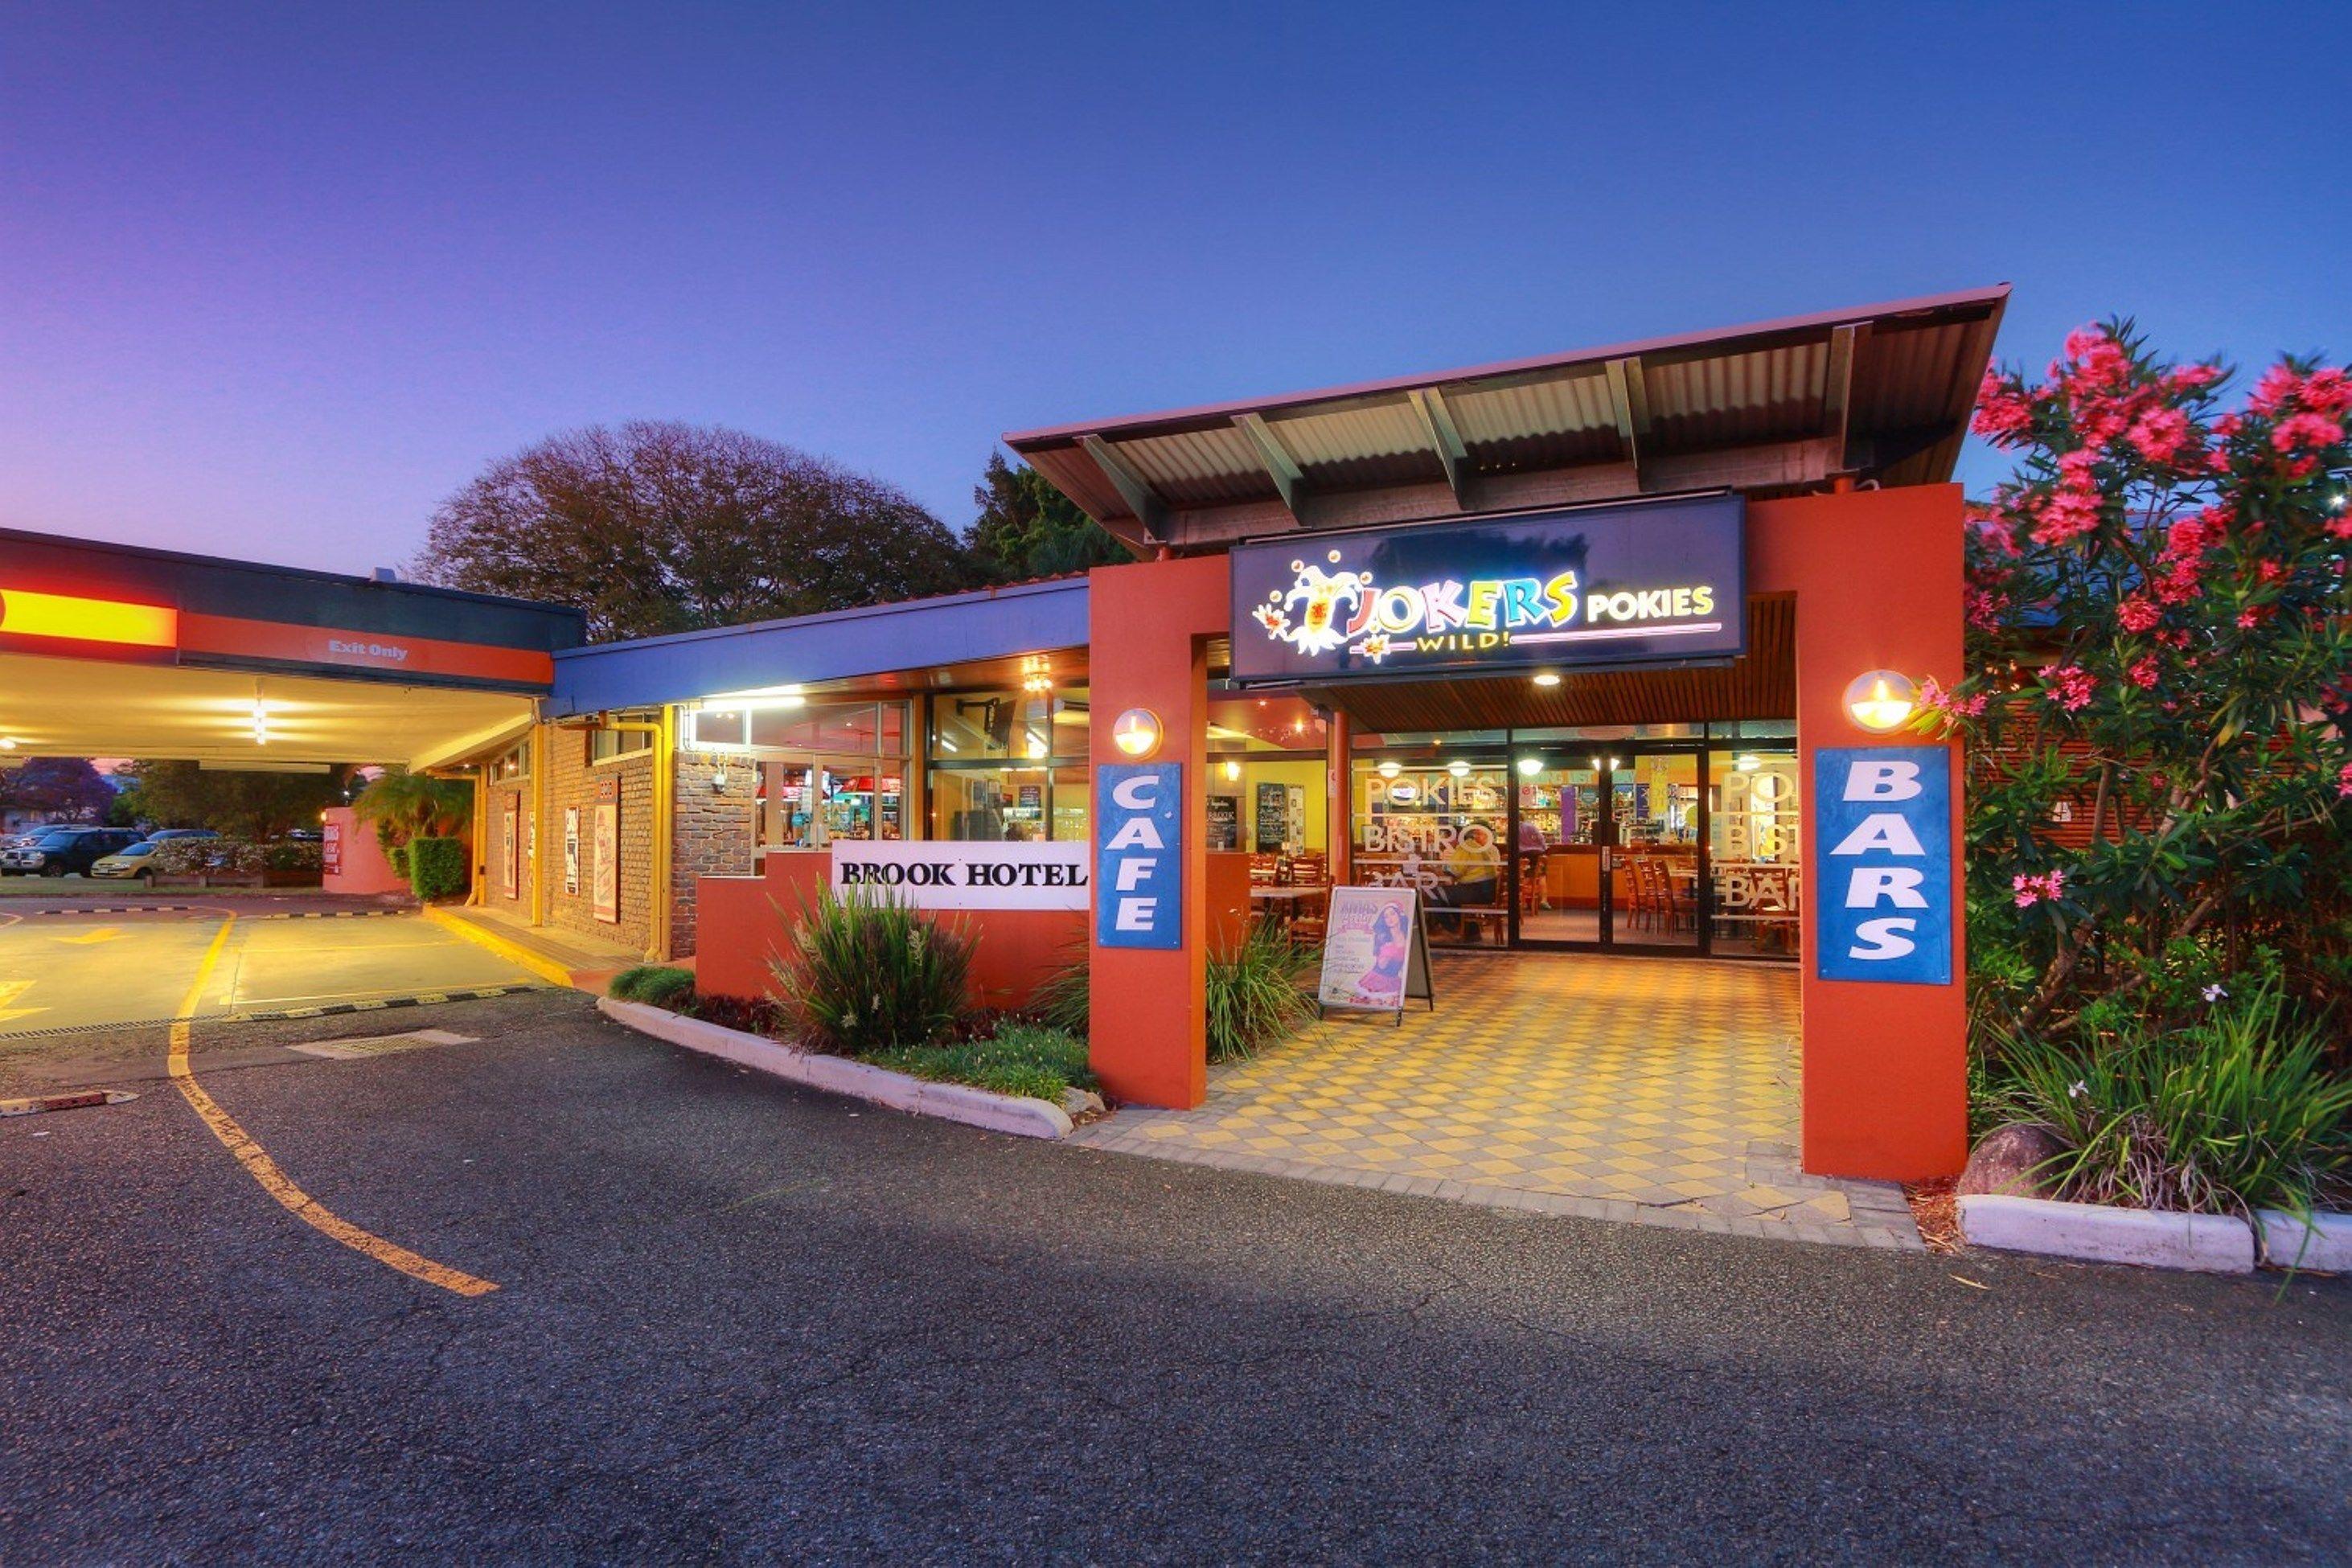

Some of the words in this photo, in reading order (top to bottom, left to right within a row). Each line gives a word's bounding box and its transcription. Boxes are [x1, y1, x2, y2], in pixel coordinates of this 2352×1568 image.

[1346, 570, 1578, 637] JOKERS
[1587, 586, 1714, 623] POKIES
[328, 639, 366, 655] Exit
[369, 644, 408, 661] Only
[1416, 632, 1511, 654] WILD!
[1365, 776, 1501, 807] POKIES
[1722, 771, 1800, 803] PO
[1105, 774, 1166, 931] CAFE
[1365, 823, 1495, 854] BISTRO
[840, 862, 957, 886] BROOK
[965, 863, 1090, 886] HOTEL
[1829, 761, 1930, 961] BARS
